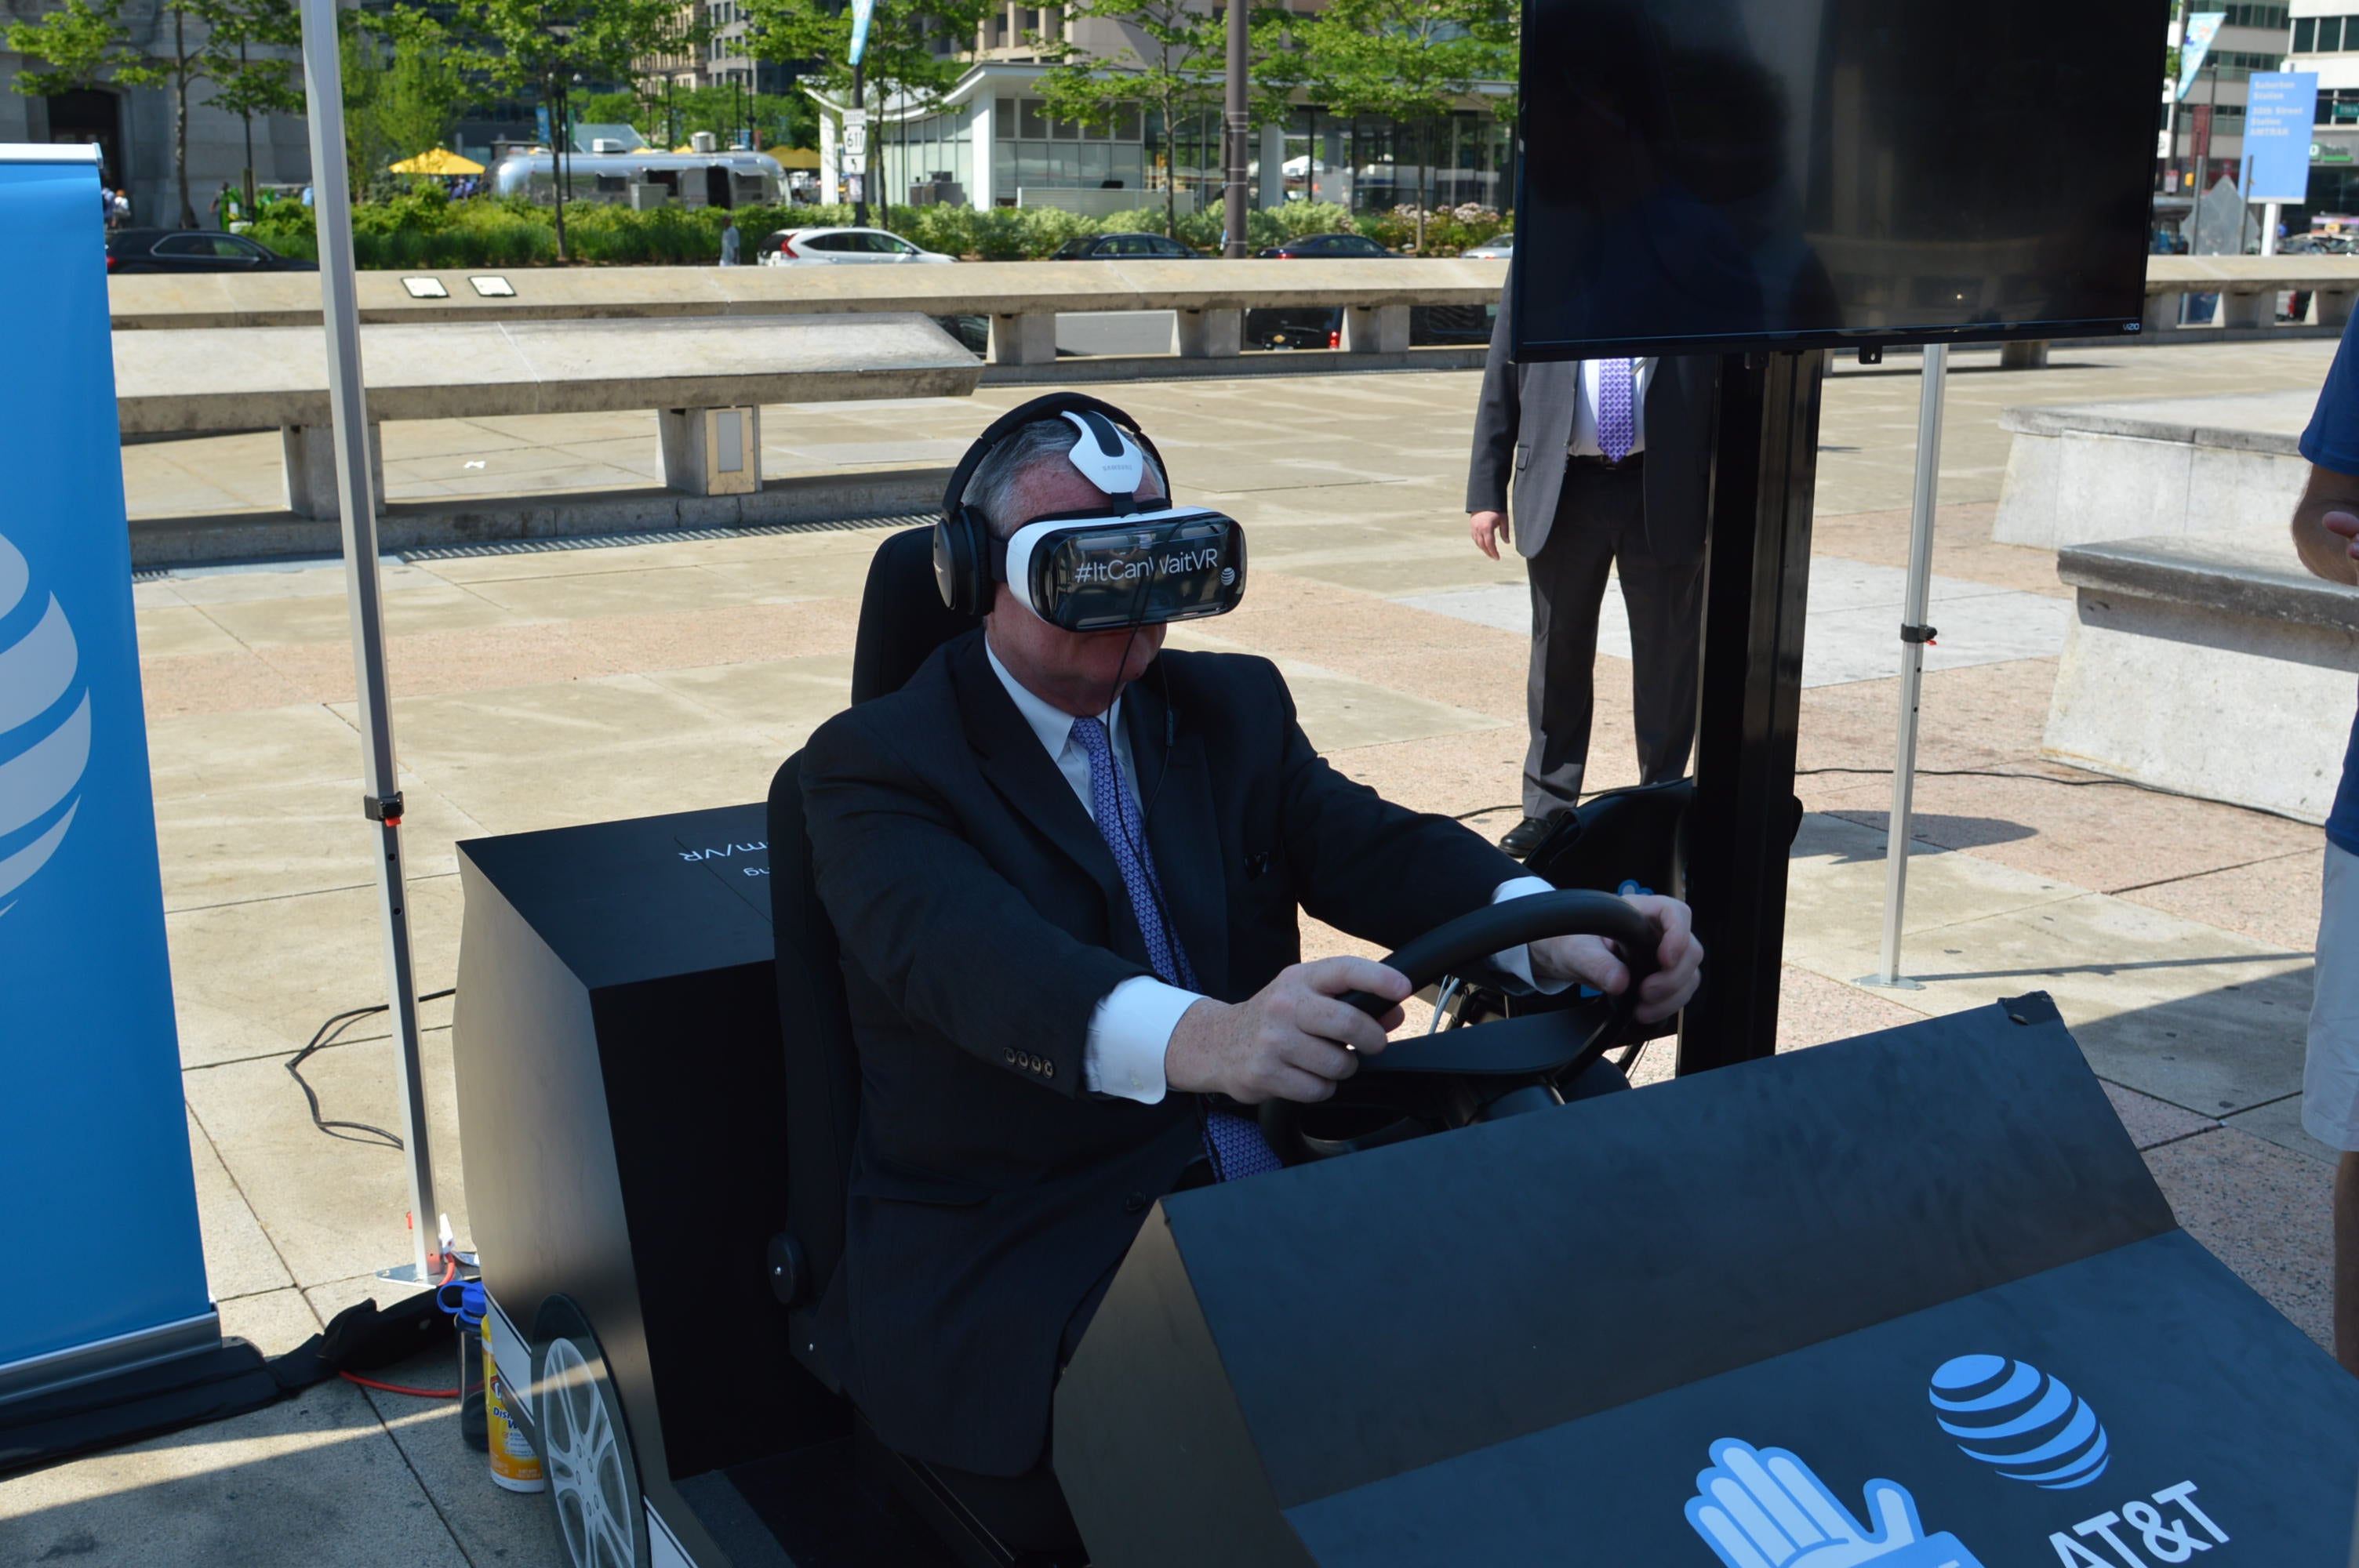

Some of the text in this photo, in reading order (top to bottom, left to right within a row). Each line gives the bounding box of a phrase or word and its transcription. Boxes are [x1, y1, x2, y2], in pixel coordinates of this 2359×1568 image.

[847, 132, 863, 147] 611
[678, 841, 769, 862] m/VR
[2048, 1480, 2230, 1568] AT&T
